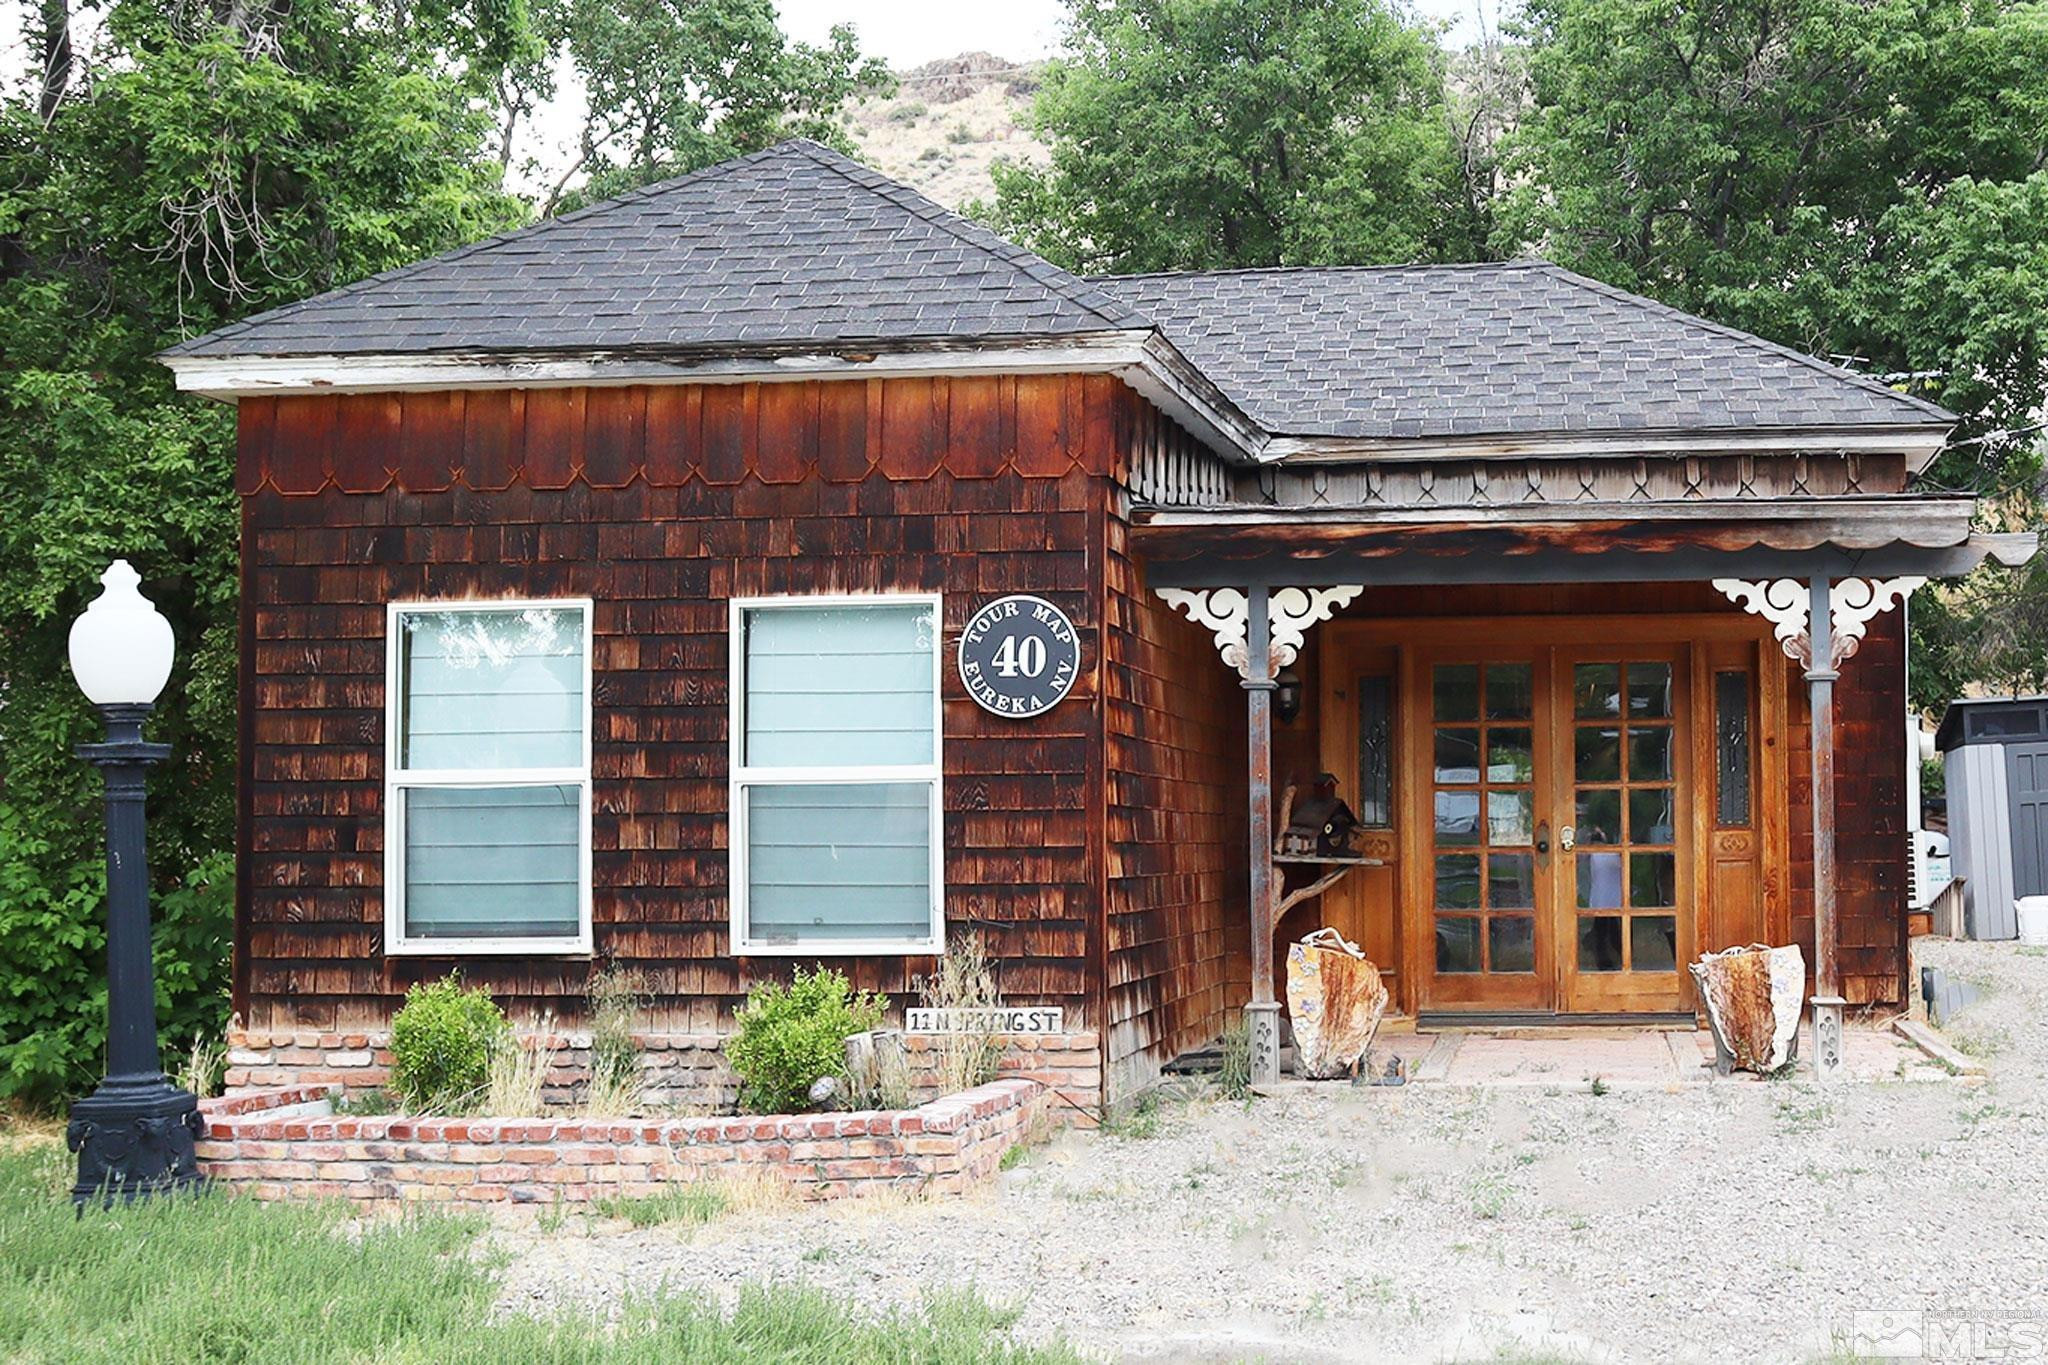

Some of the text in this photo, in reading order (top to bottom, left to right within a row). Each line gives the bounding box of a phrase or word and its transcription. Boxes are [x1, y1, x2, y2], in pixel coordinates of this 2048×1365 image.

[968, 602, 1072, 643] TOUR MAP
[992, 635, 1046, 678] 40
[964, 660, 1073, 712] EUREKA NV
[911, 1013, 930, 1031] 11
